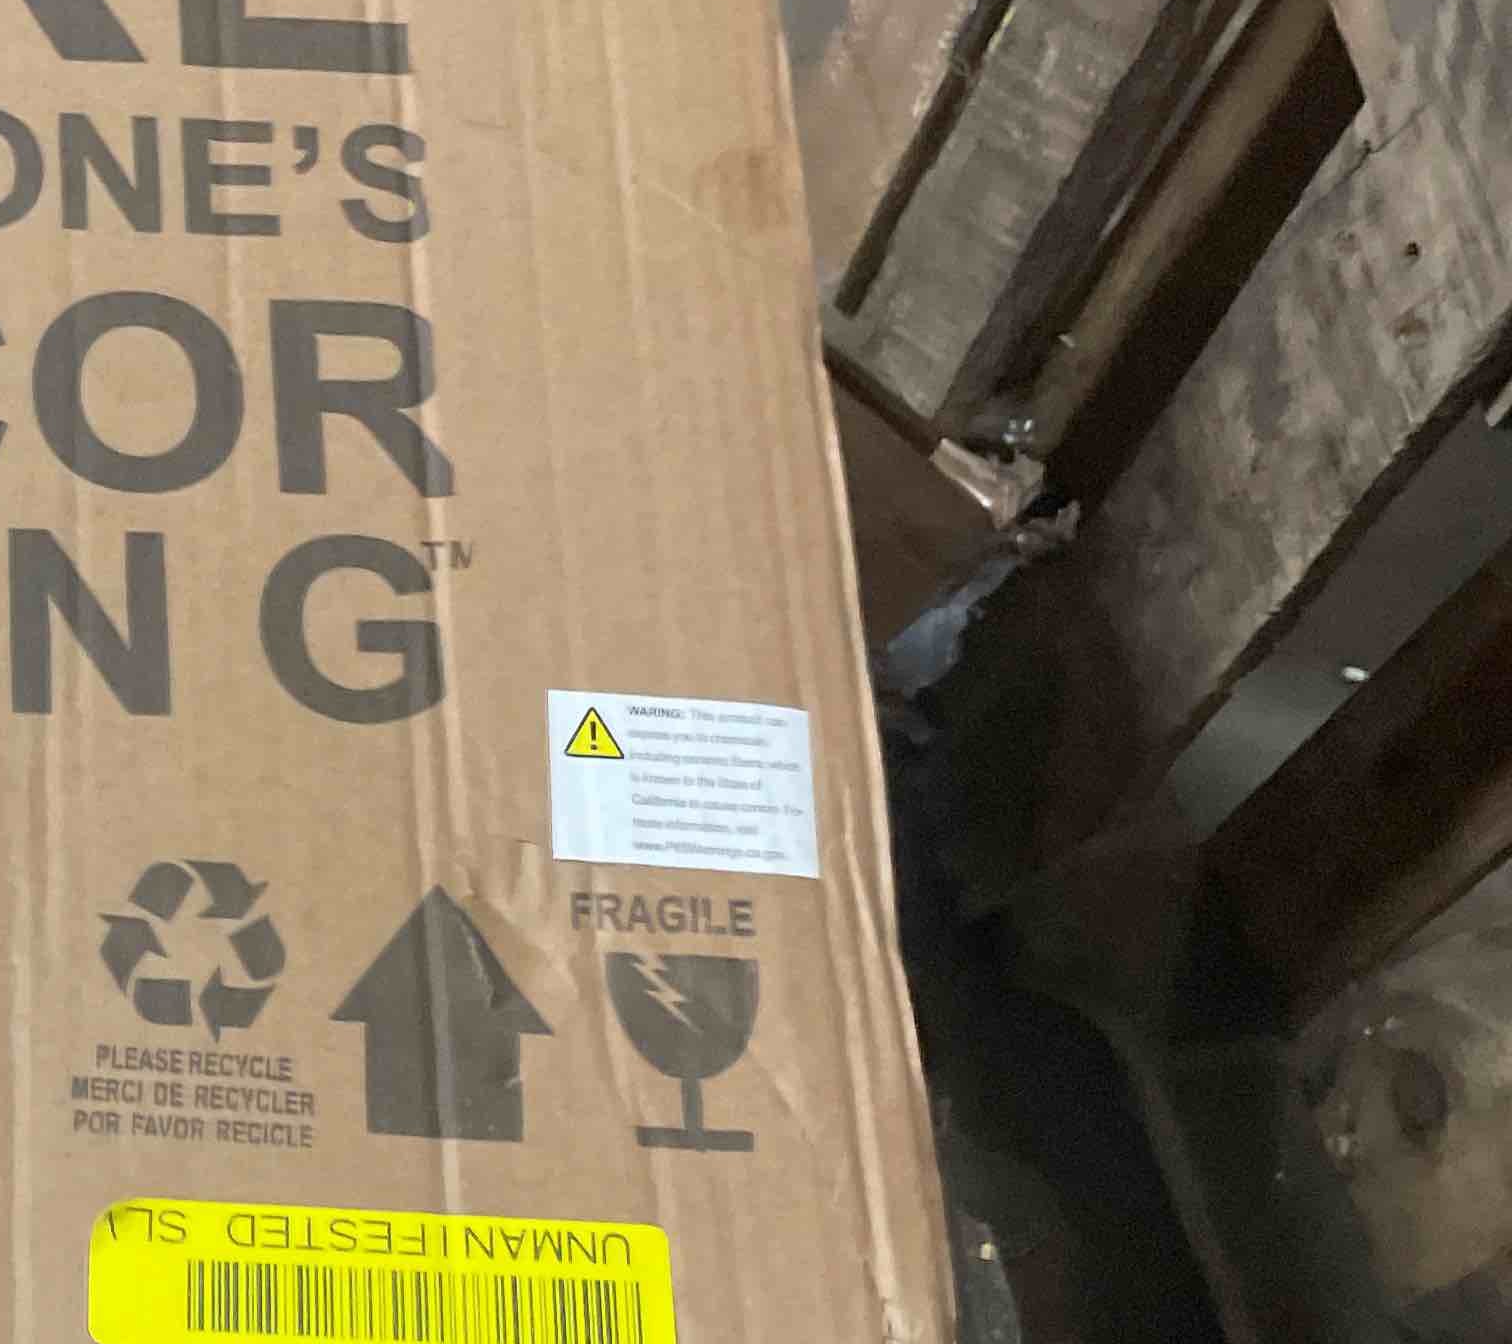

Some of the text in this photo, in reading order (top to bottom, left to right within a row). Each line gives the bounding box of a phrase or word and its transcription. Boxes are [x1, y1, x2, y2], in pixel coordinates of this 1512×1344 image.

[569, 891, 757, 936] FRAGILE
[95, 1044, 294, 1083] PLEASE RECYCLE
[71, 1075, 316, 1117] MERCI DE RECYCLER
[73, 1109, 313, 1149] POR FAVOR RECICLE
